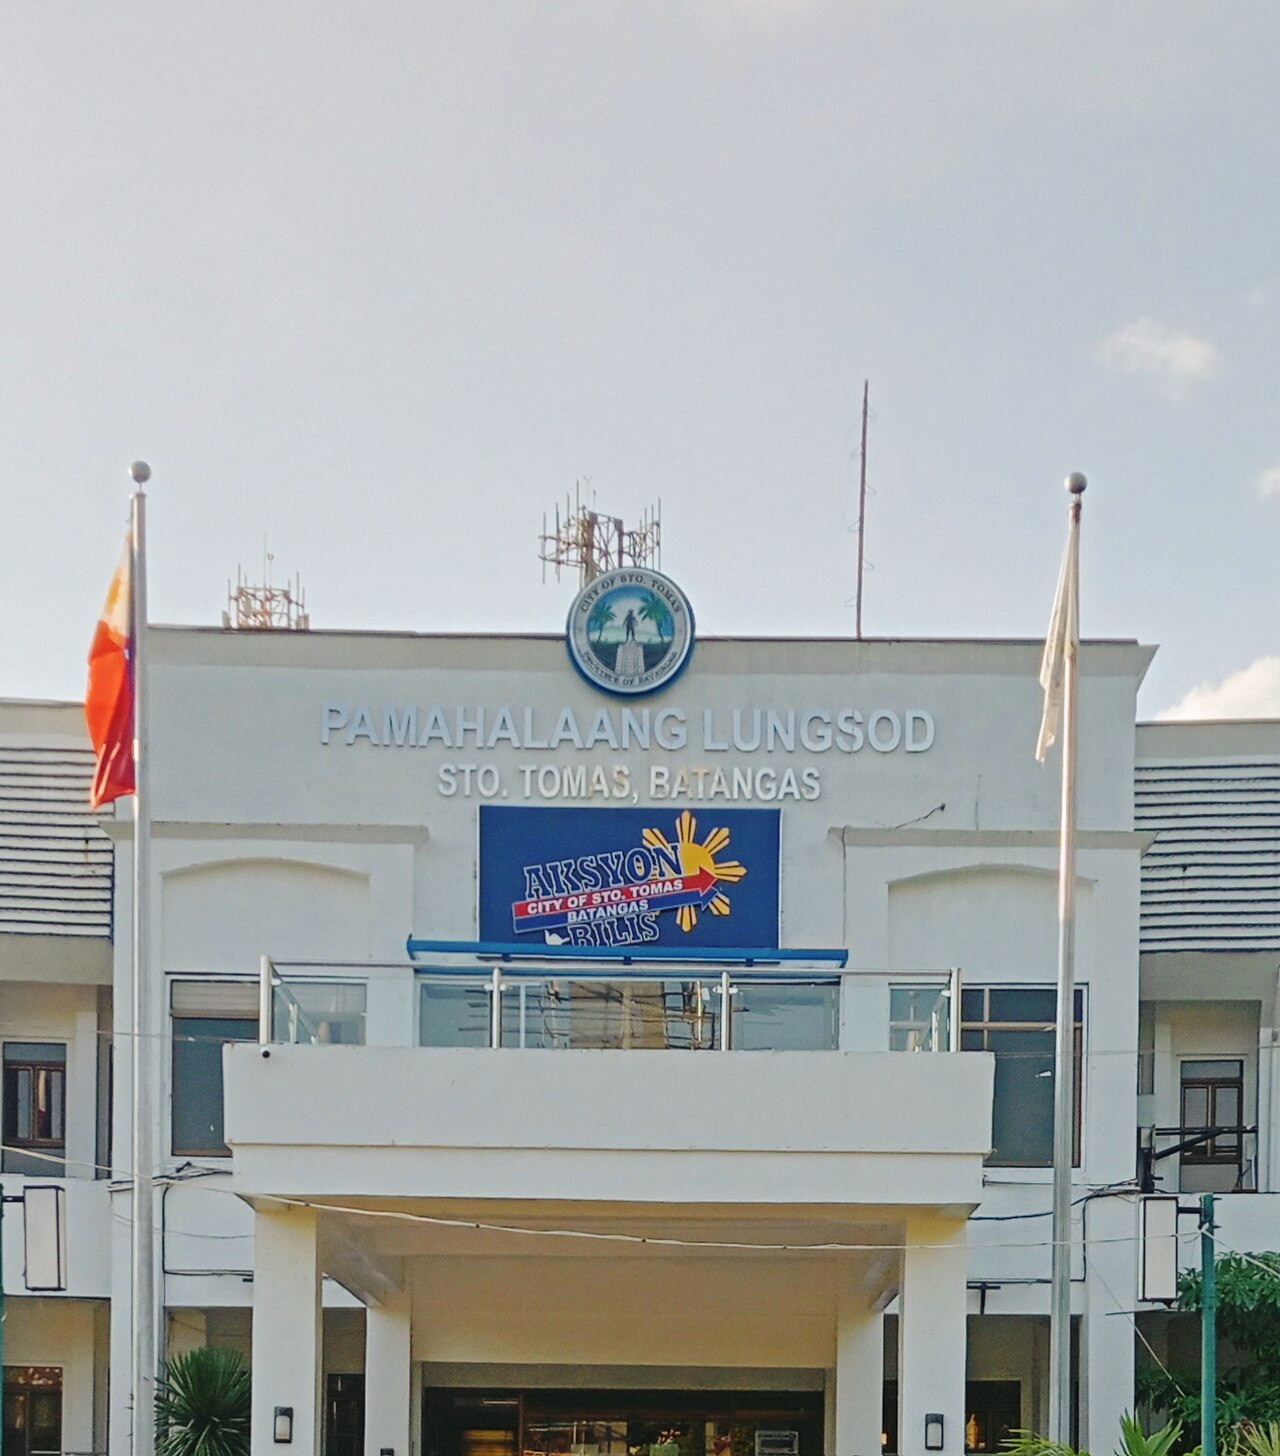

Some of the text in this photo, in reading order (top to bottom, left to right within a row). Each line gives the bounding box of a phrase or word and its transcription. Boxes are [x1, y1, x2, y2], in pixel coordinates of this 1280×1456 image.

[580, 587, 600, 613] CITY
[601, 578, 616, 589] OF
[651, 581, 682, 613] TOMAS
[320, 703, 936, 753] PAMAHALAANG LUNGSOD
[438, 763, 821, 804] STO. TOMAS, BATANGAS
[523, 842, 684, 901] AKSYON
[527, 879, 684, 915] CITY OF STO. TOMAS
[567, 899, 649, 923] BATANGAS
[567, 912, 661, 947] BILIS
